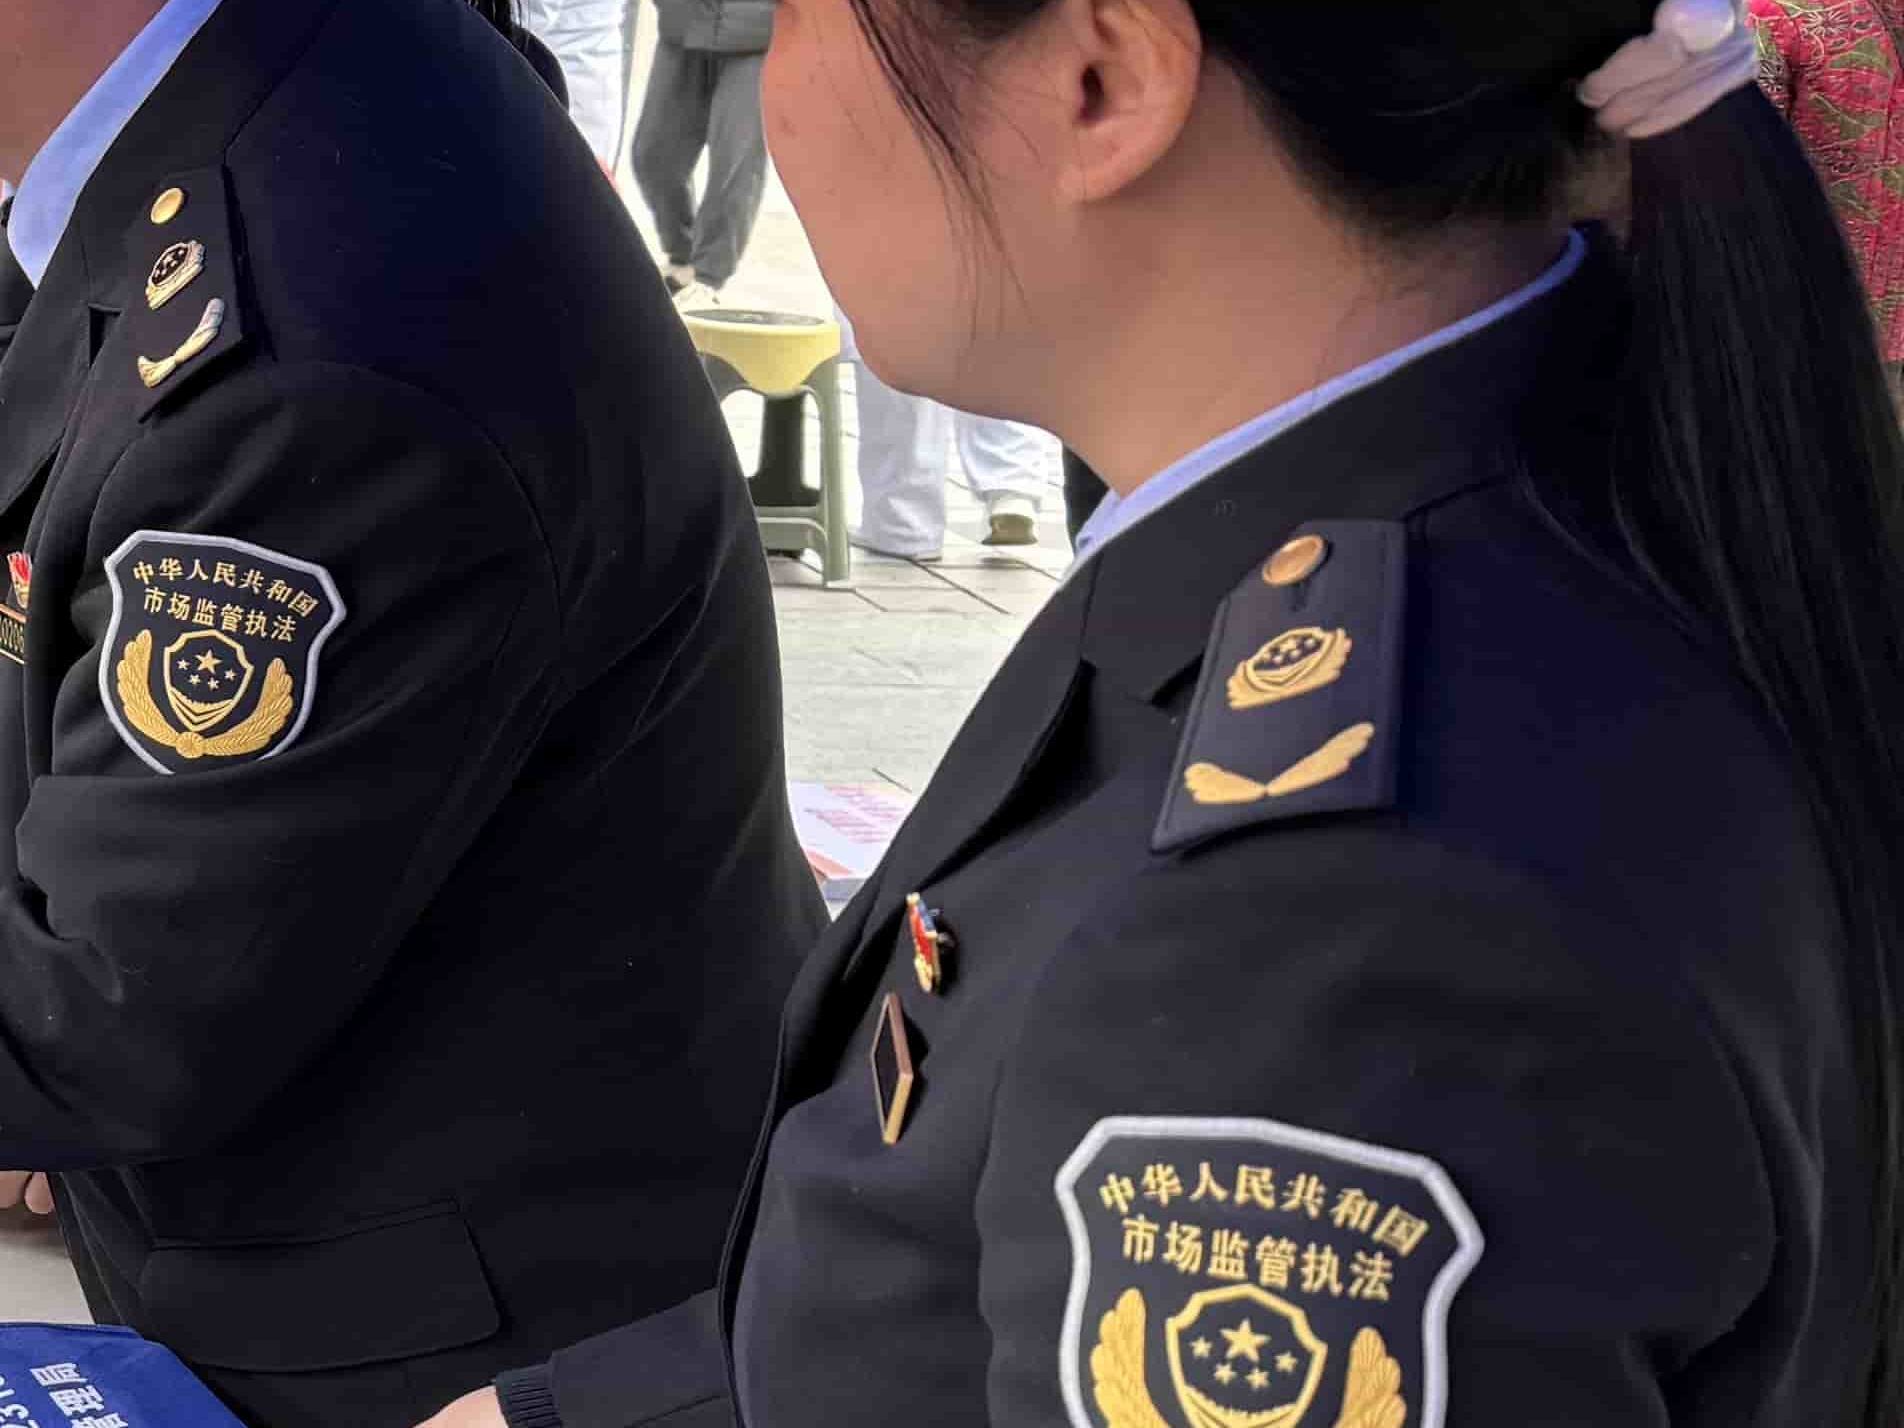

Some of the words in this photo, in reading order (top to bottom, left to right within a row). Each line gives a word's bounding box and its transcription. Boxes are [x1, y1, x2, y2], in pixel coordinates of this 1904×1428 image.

[132, 557, 320, 617] 中华人民共和国
[142, 587, 297, 643] 市场监管执法
[1098, 1162, 1430, 1257] 中华人民共和国
[1121, 1213, 1394, 1302] 市场监管执法
